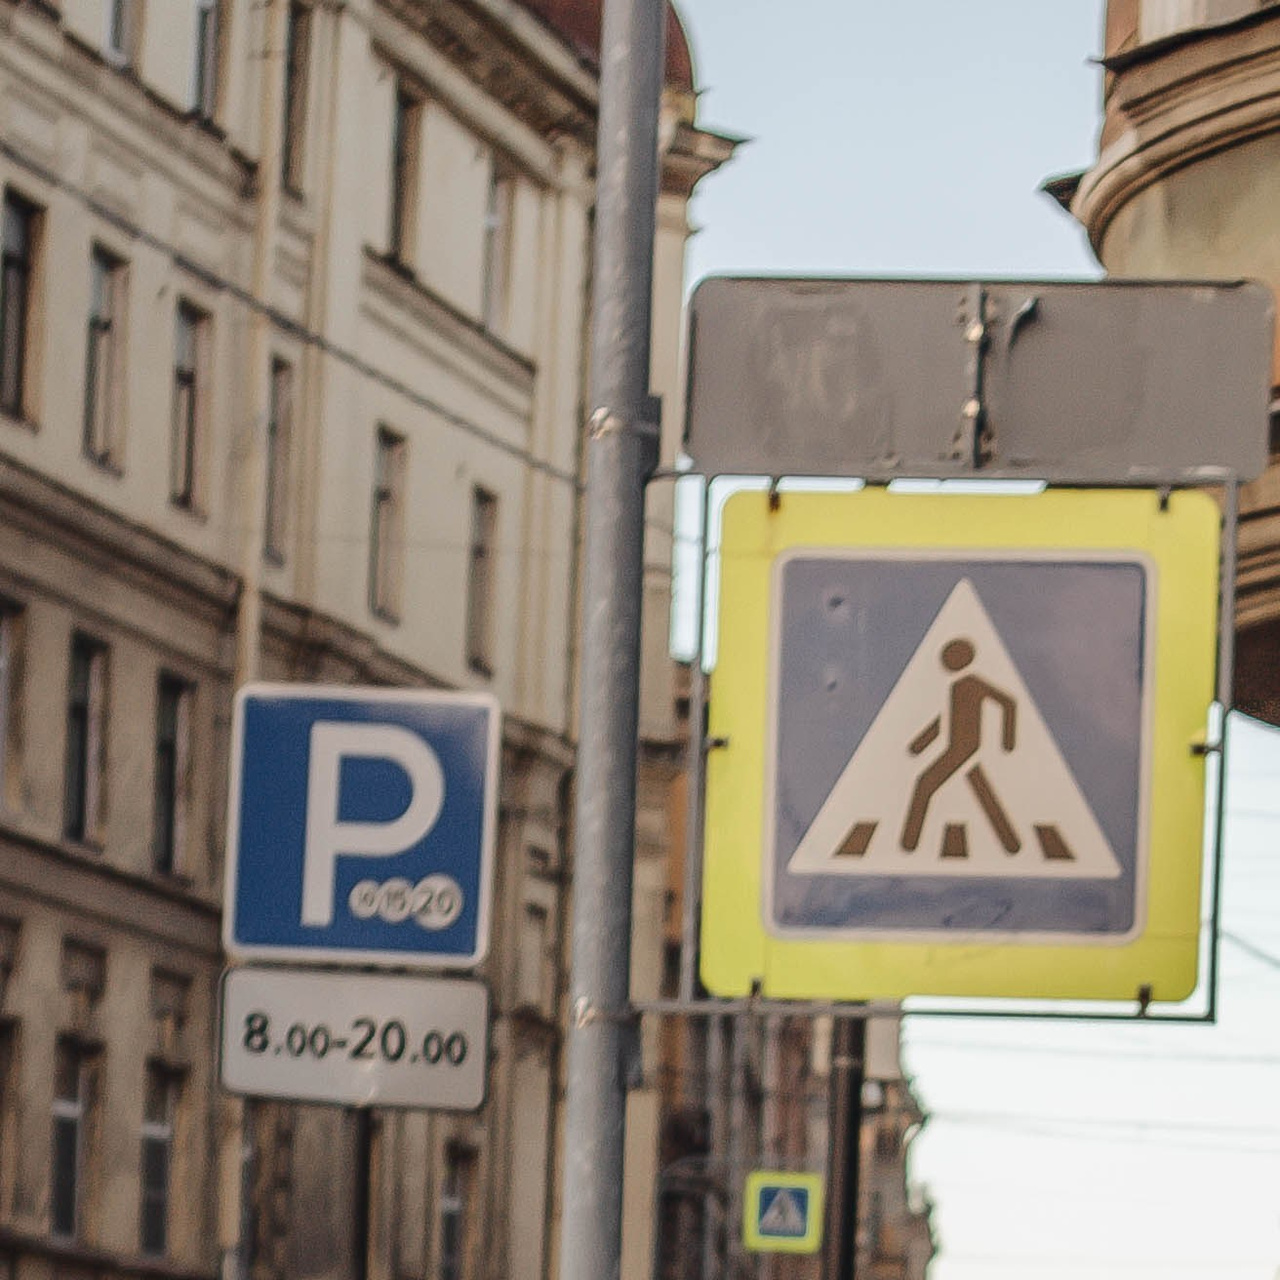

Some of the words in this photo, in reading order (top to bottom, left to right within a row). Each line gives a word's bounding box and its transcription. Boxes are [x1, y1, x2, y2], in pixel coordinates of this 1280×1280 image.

[302, 719, 445, 928] P
[416, 888, 455, 915] 20
[243, 1011, 468, 1066] 8.00-20.00
